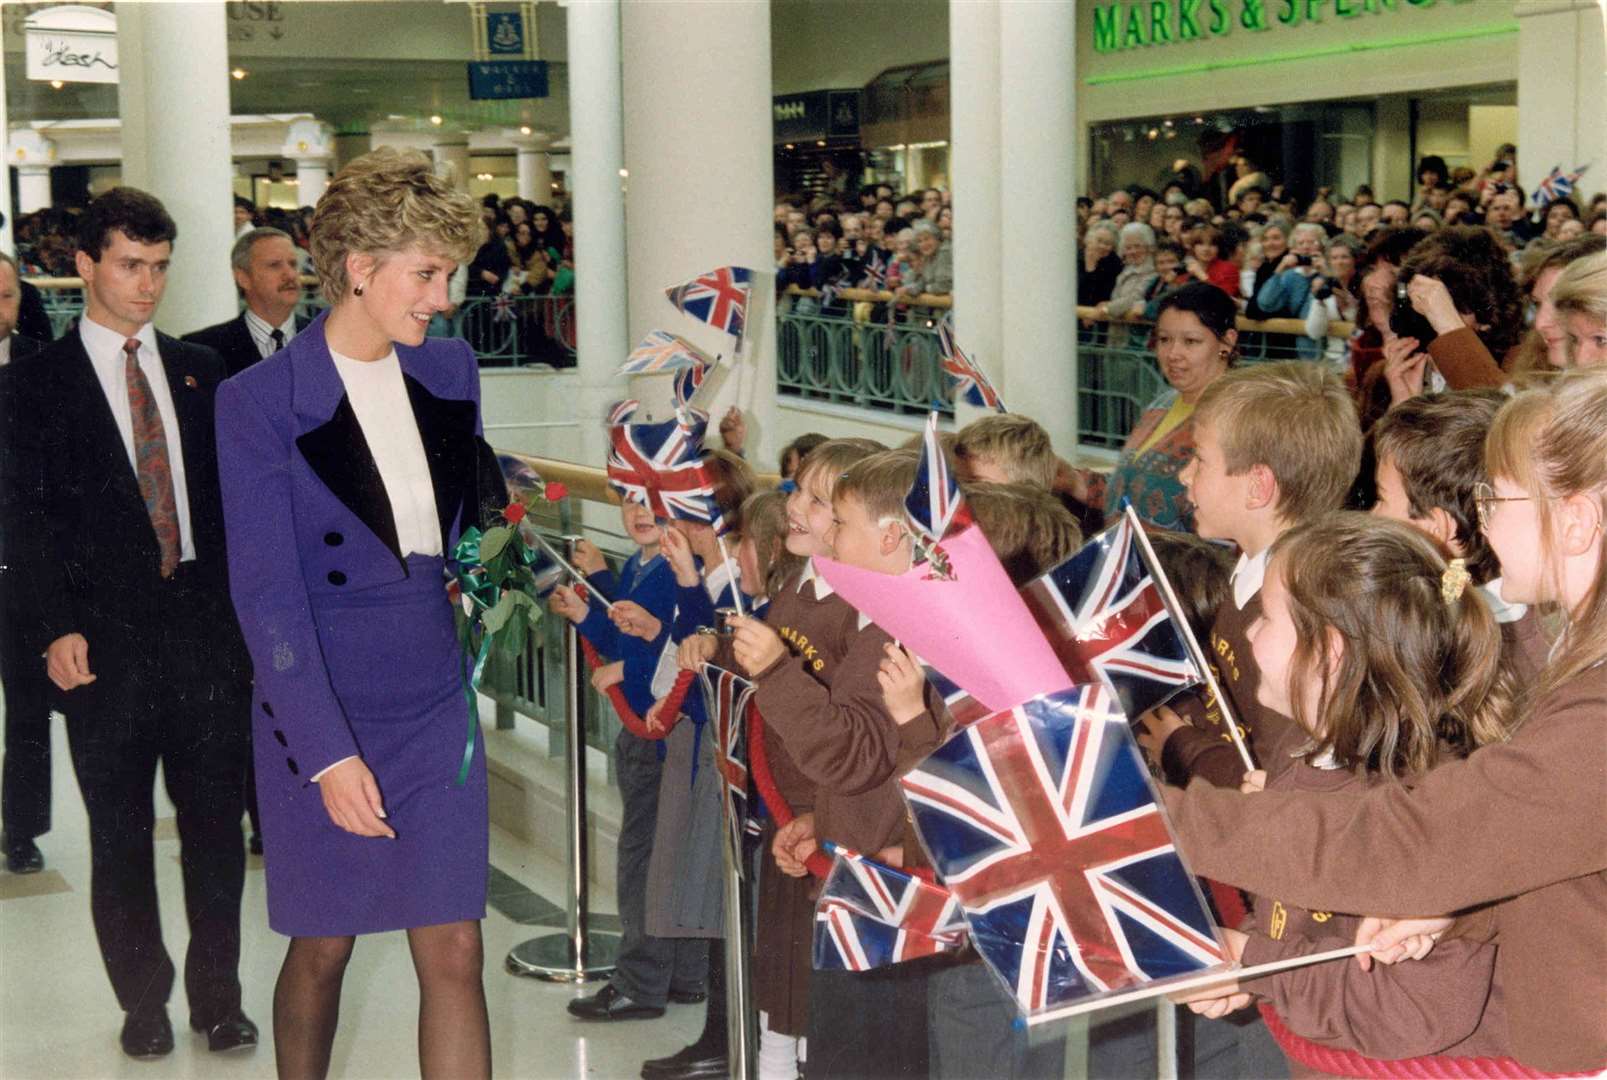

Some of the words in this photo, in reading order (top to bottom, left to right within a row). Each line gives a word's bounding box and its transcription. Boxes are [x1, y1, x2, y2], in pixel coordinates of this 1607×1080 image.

[1094, 0, 1231, 53] MARKS
[1240, 0, 1266, 31] &
[779, 626, 825, 672] MARKS
